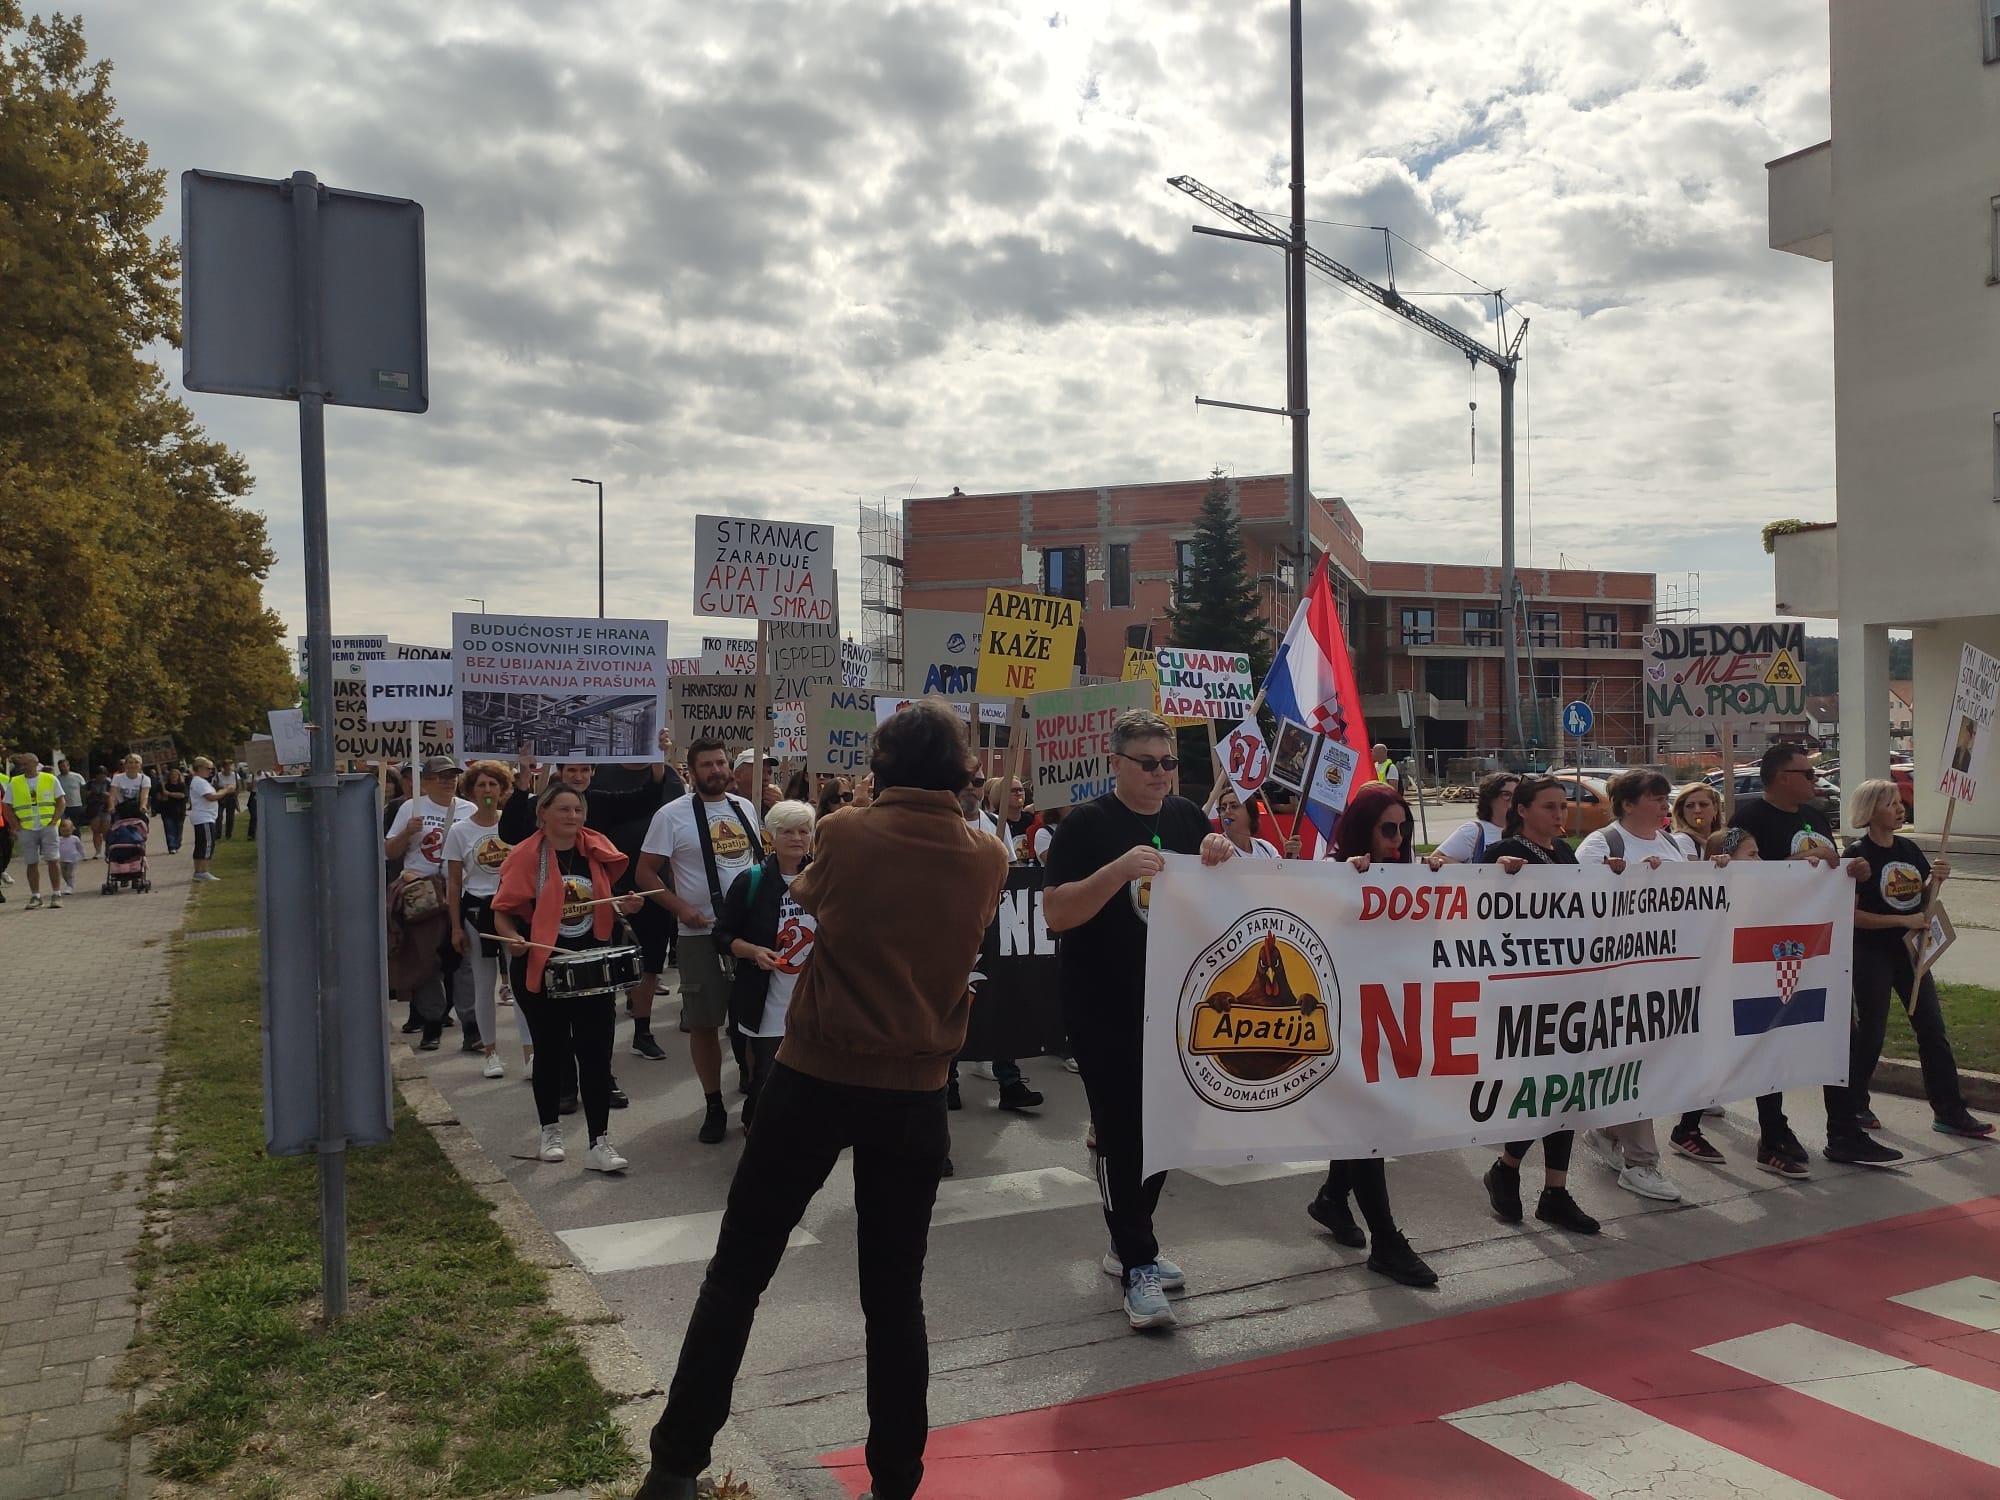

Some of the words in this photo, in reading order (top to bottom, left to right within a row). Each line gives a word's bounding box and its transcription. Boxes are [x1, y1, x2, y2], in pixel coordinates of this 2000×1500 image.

[717, 520, 819, 552] STRANAC
[706, 565, 814, 596] APATIJA
[700, 592, 759, 615] GUTA
[770, 595, 832, 620] SMRAD
[987, 592, 1074, 630] APATIJA
[344, 639, 382, 649] PRIRODU
[470, 623, 574, 639] BUDUĆNOST
[576, 628, 592, 639] JE
[596, 628, 650, 641] HRANA
[703, 638, 722, 650] TKO
[989, 629, 1052, 660] KAŽE
[462, 640, 487, 651] OD
[491, 641, 579, 655] OSNOVNIH
[583, 644, 656, 657] SIROVINA
[842, 643, 872, 664] PRAVO
[1157, 647, 1250, 674] ČUVAJMO
[466, 656, 496, 669] BEZ
[500, 657, 573, 671] UBIJANJA
[576, 657, 653, 672] ŽIVOTINJA
[1005, 664, 1037, 690] NE
[1677, 653, 1772, 685] NIJE
[470, 671, 578, 687] UNIŠTAVANJA
[583, 673, 656, 688] PRAŠUMA
[681, 683, 738, 698] HRVATSKOJ
[1158, 668, 1203, 689] LIKU
[1204, 681, 1254, 700] SISAK
[681, 704, 732, 720] TREBAJU
[1163, 697, 1243, 719] APATIJU
[1646, 682, 1694, 718] NA
[1704, 682, 1806, 716] PRODAJU
[1038, 761, 1099, 786] PRLJAVI
[715, 840, 747, 851] Apatija
[563, 904, 588, 917] patija
[1359, 885, 1468, 921] DOSTA
[1477, 891, 1585, 921] ODLUKA
[1592, 891, 1607, 918] U
[1612, 889, 1637, 917] IME
[1638, 885, 1731, 914] GRAĐANA,
[1206, 930, 1244, 968] STOP
[1246, 917, 1284, 937] FARMI
[1288, 922, 1324, 967] PILIĆA
[1432, 939, 1452, 968] A
[1458, 939, 1497, 968] NA
[1501, 932, 1585, 967] ŠTETU
[1590, 929, 1677, 964] GRAĐANA!
[1212, 1013, 1317, 1047] Apatija
[1360, 981, 1481, 1083] NE
[1496, 986, 1701, 1060] MEGAFARMI
[1199, 1066, 1222, 1091] SELO
[1224, 1086, 1280, 1101] DOMAĆIH
[1284, 1067, 1318, 1094] KOKA
[1469, 1079, 1503, 1123] U
[1507, 1060, 1643, 1120] APATIJI!
